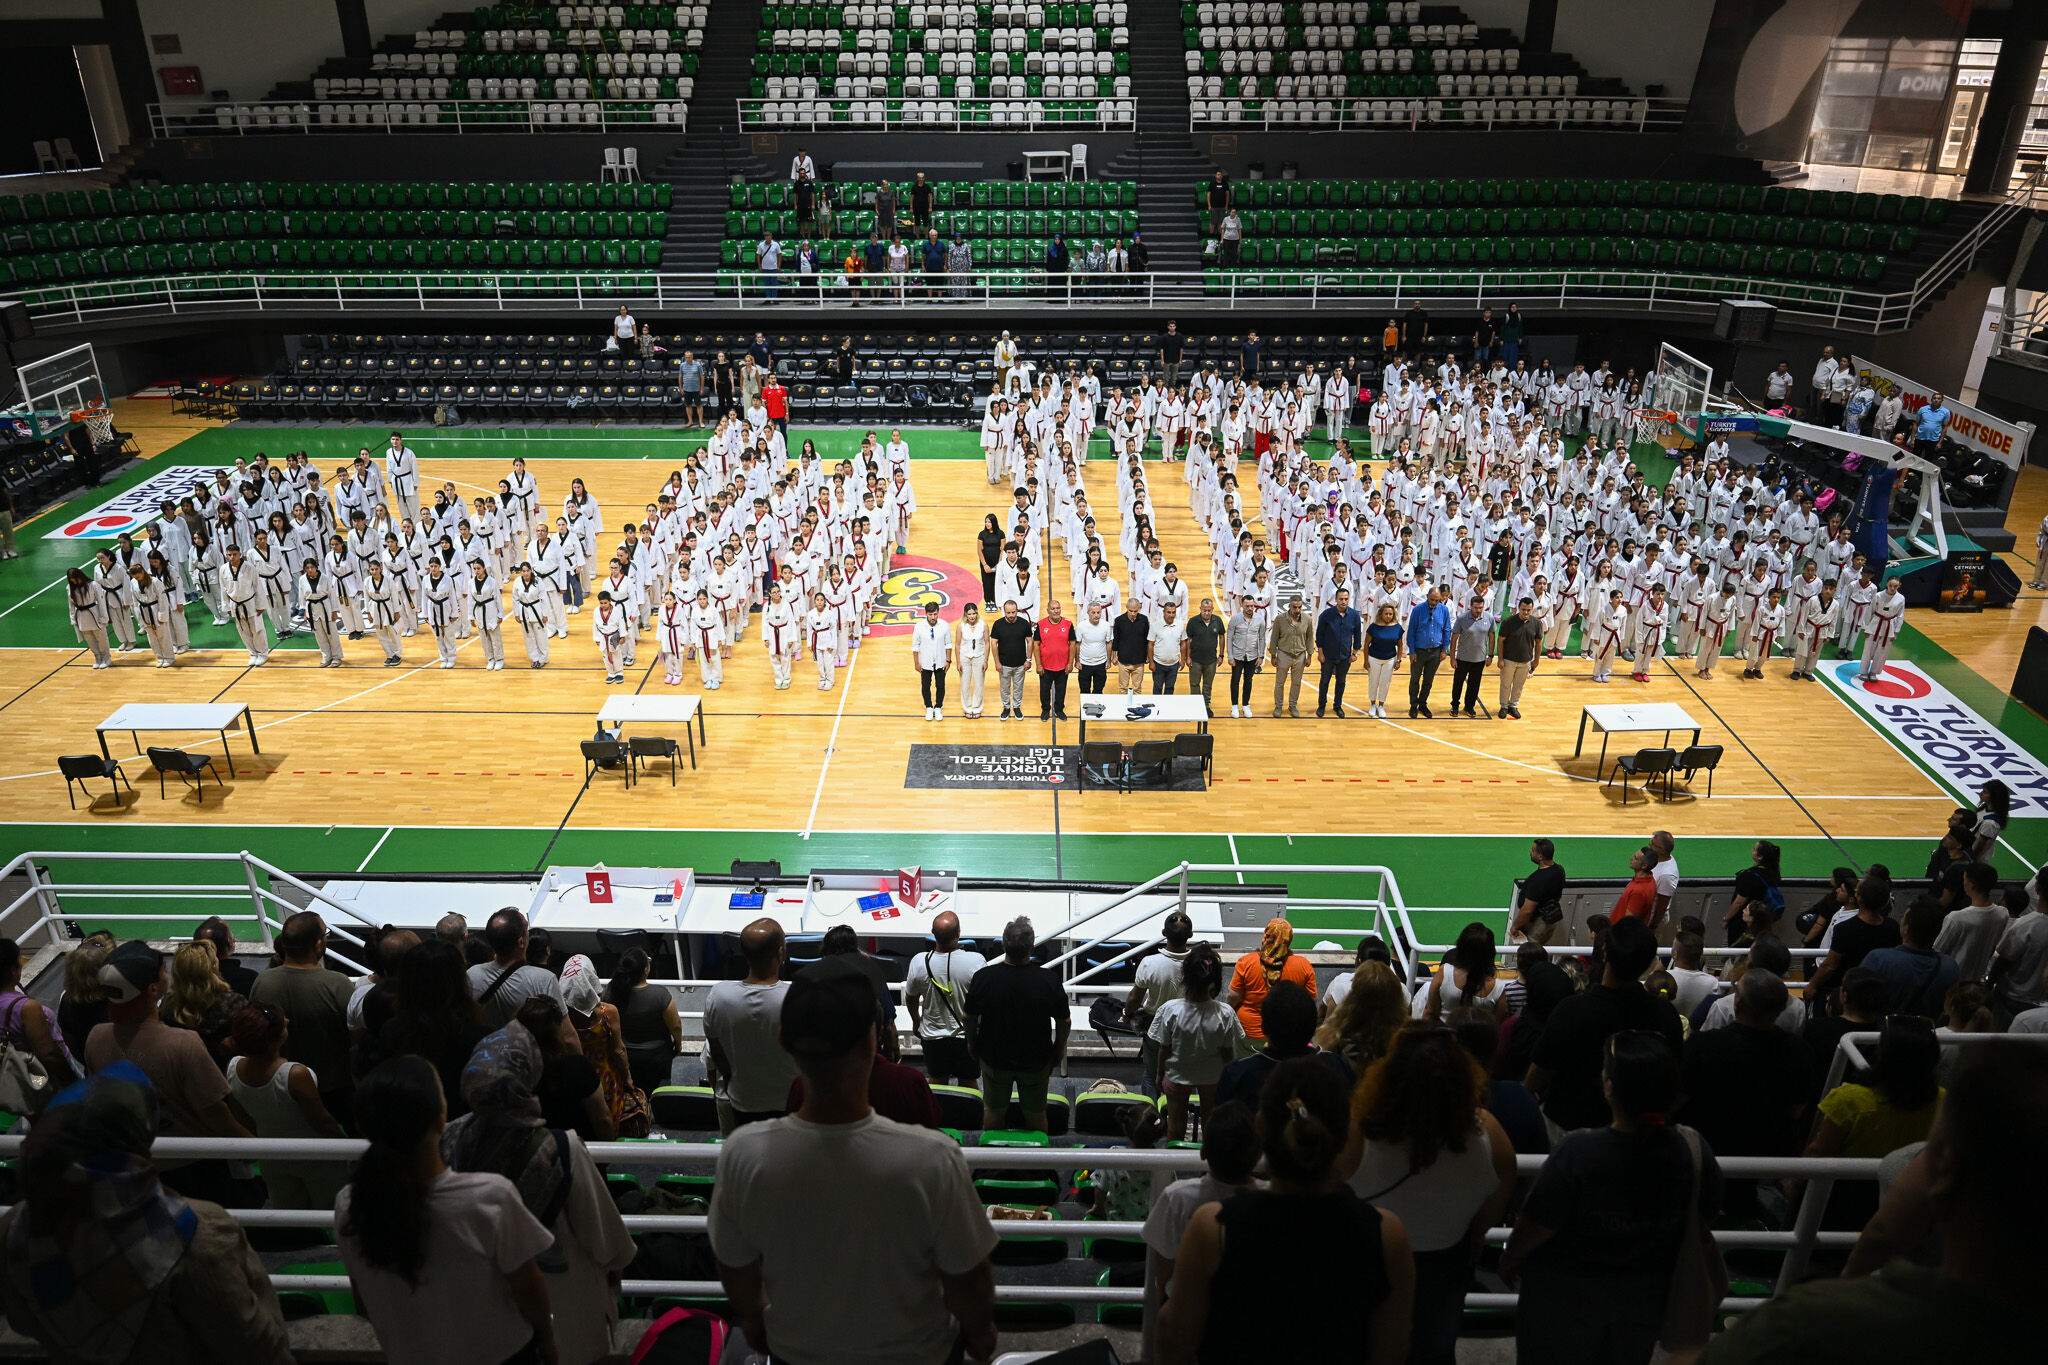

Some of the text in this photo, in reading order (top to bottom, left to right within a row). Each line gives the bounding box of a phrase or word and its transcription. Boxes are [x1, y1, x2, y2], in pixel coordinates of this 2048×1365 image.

[1949, 409, 2014, 455] OURTSIDE
[98, 467, 200, 514] TÜRKİYE
[948, 755, 1064, 765] BASKETBOL
[981, 764, 1064, 774] TÜRKİYE
[593, 880, 606, 895] 5
[902, 880, 911, 896] 5
